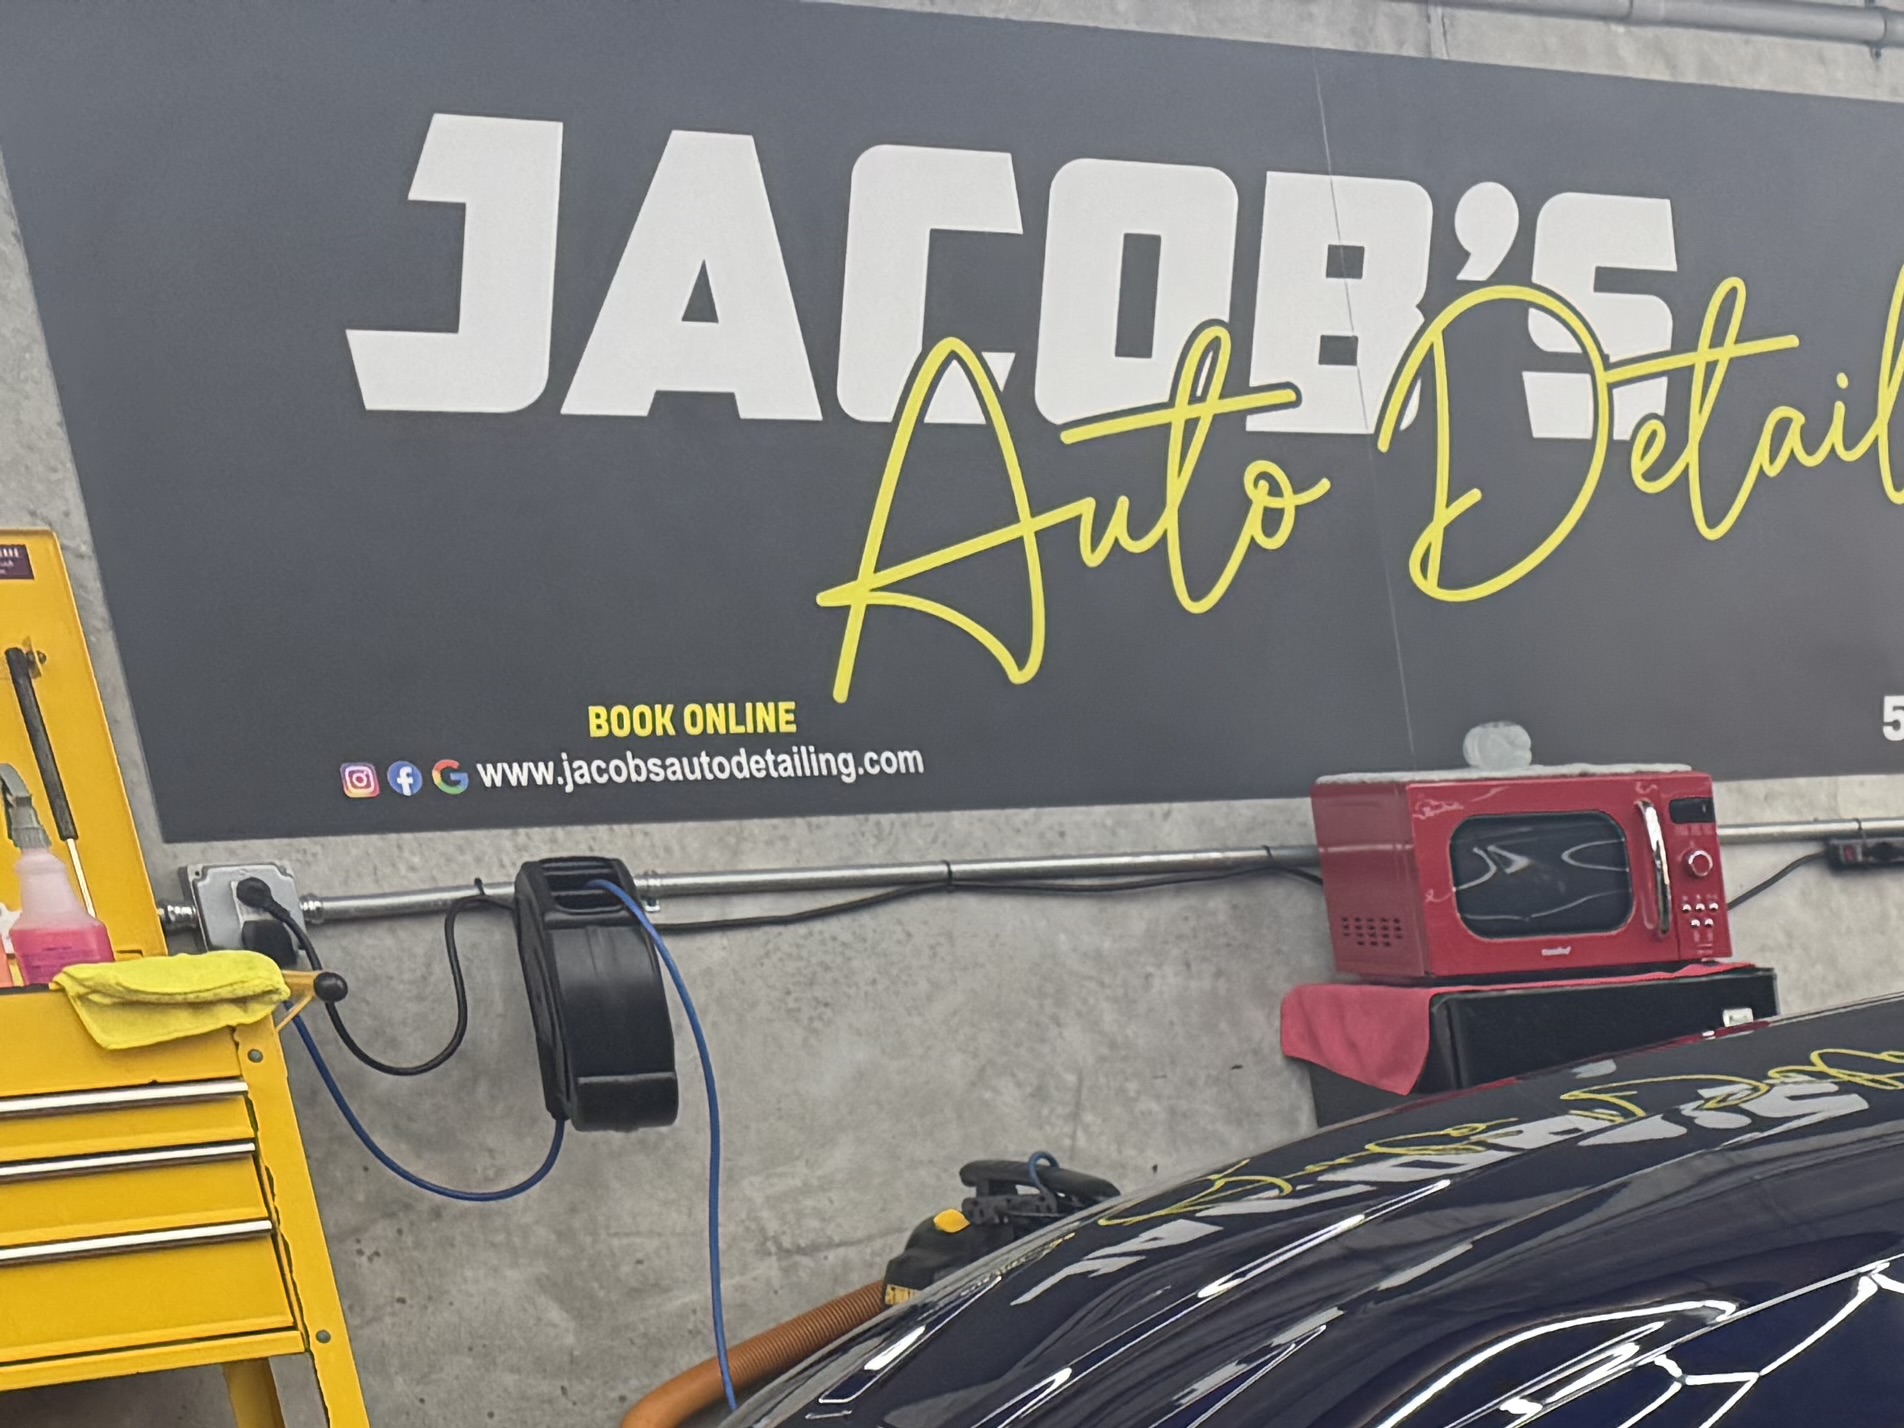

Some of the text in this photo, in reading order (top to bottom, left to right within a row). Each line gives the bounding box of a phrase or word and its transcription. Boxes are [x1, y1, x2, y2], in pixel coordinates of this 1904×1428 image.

[345, 112, 1678, 440] JACOB'S
[815, 318, 1331, 703] Auto
[476, 745, 925, 794] www.jacobsautodetailing.com
[587, 701, 798, 738] BOOK ONLINE
